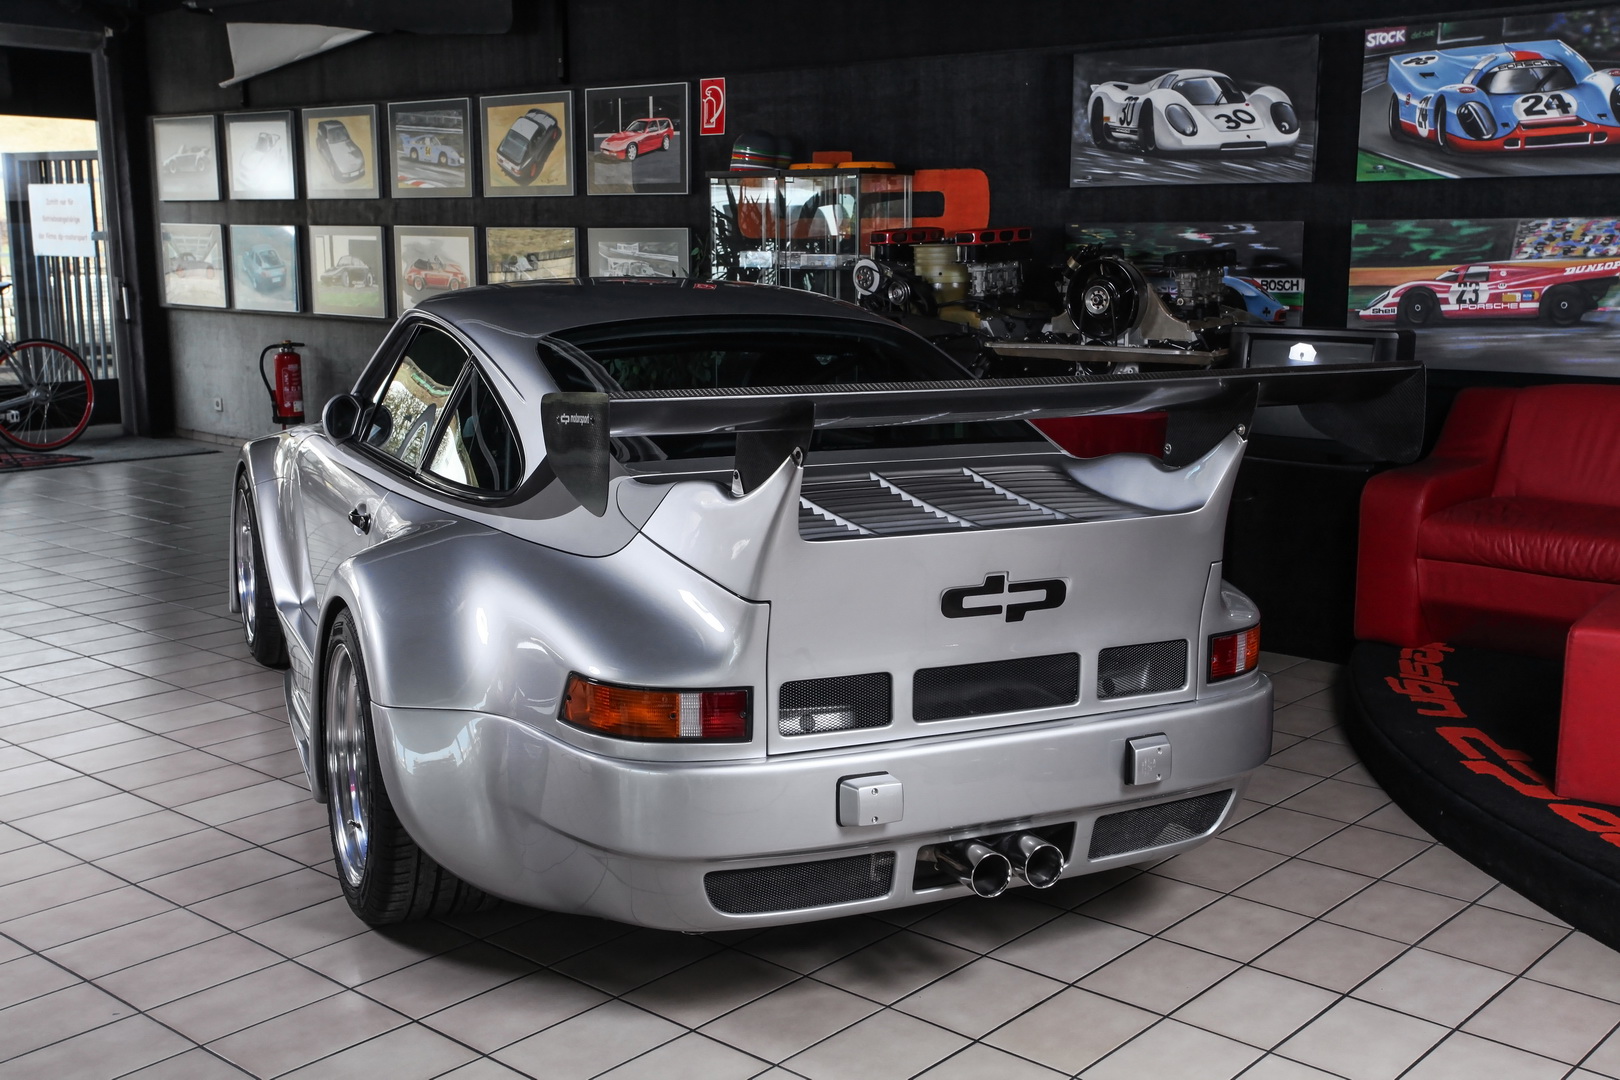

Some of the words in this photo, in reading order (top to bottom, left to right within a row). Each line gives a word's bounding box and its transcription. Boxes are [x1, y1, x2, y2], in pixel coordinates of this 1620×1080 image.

[1366, 29, 1405, 47] STOCK
[1521, 93, 1572, 117] 24
[1214, 109, 1256, 130] 30
[1261, 279, 1299, 292] BOSCH
[1455, 282, 1480, 304] 23
[1460, 302, 1519, 310] PORSCHE
[940, 573, 1067, 623] dp
